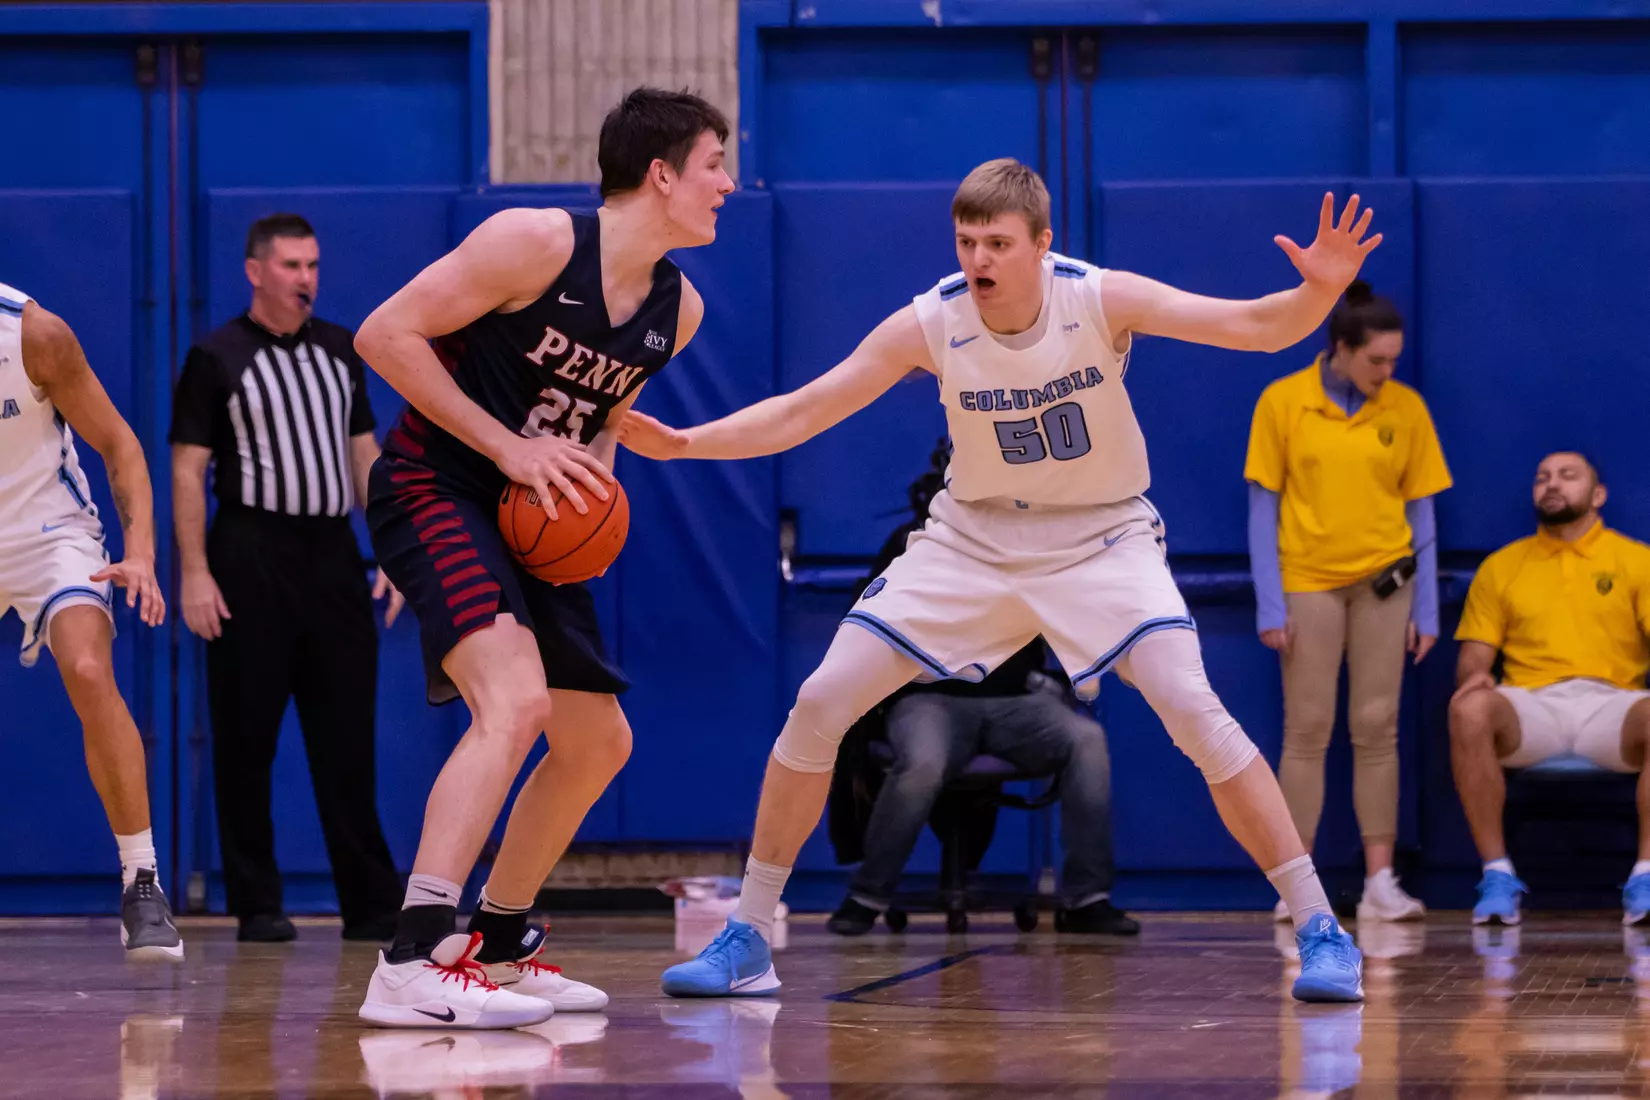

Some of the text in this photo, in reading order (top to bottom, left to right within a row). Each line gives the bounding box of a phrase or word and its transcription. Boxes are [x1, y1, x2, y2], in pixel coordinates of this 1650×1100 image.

[525, 325, 644, 397] PENN
[650, 334, 667, 347] IVY
[521, 387, 597, 444] 25
[959, 366, 1104, 411] COLUMBIA
[993, 401, 1092, 464] 50
